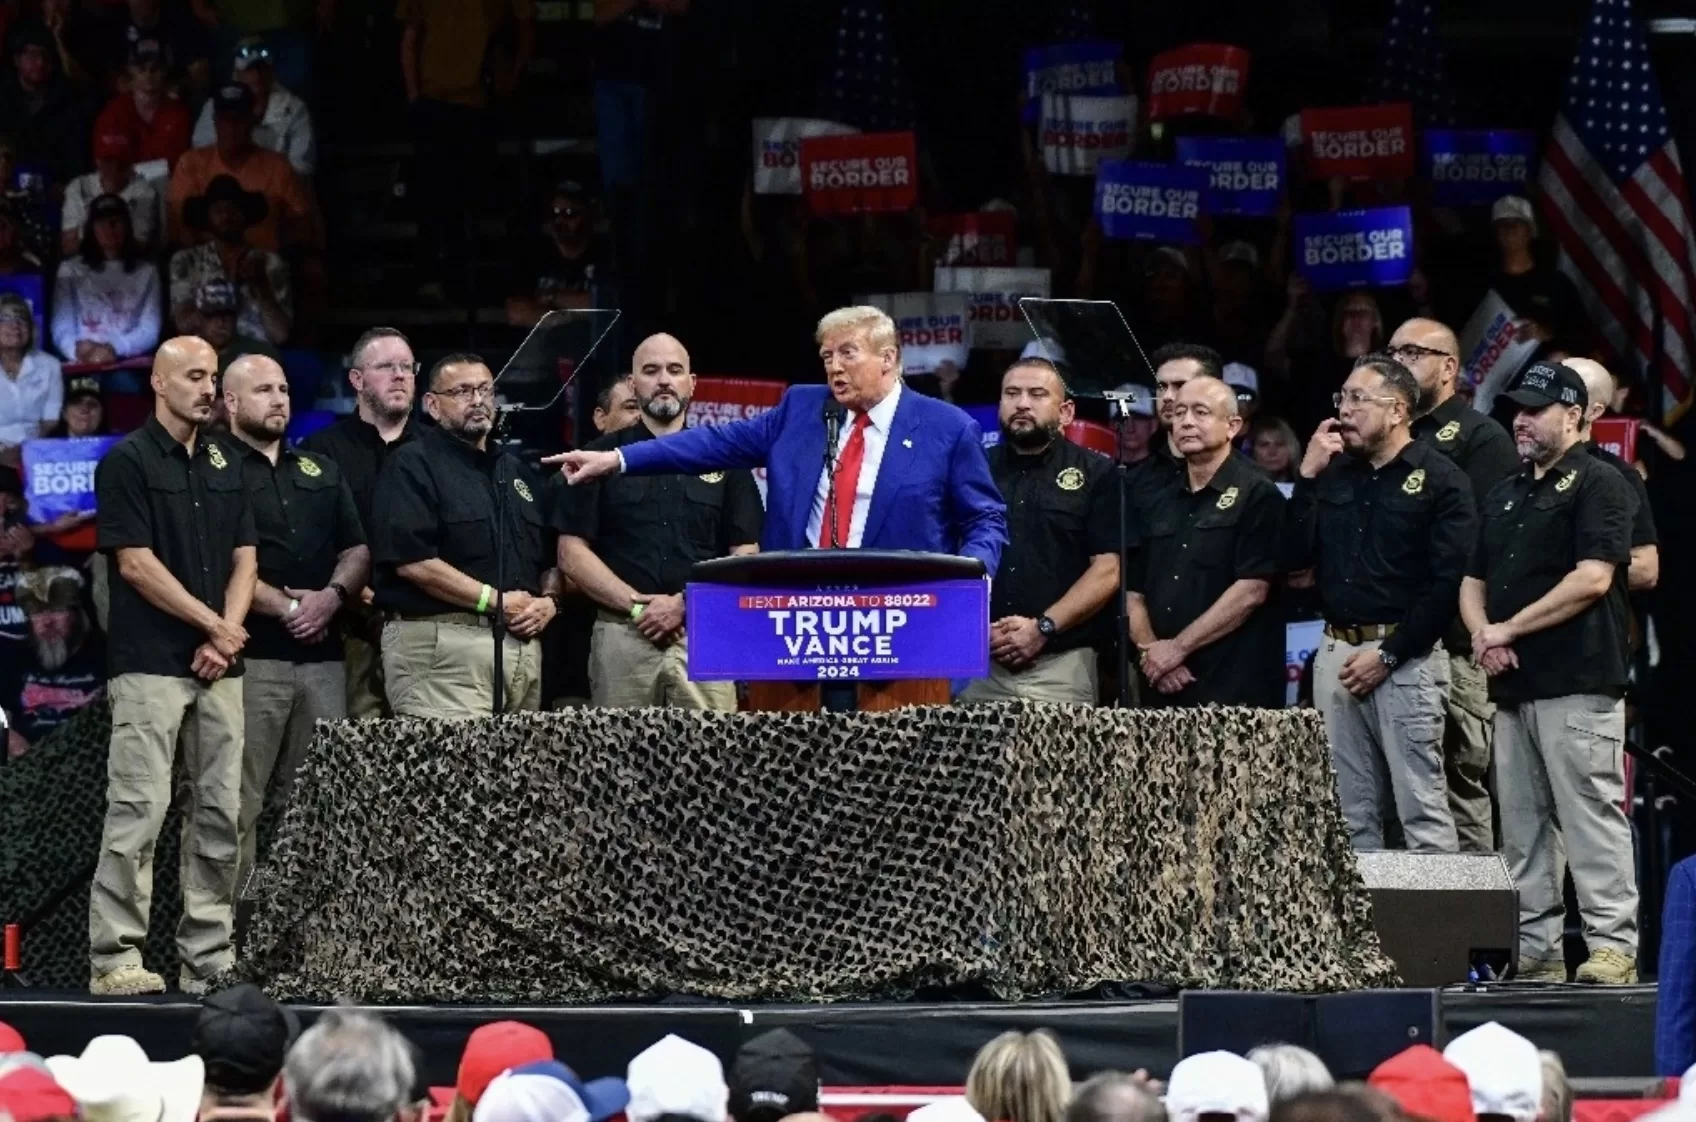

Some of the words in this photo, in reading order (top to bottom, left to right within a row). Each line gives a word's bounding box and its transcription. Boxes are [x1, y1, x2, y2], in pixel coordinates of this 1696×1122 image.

[1312, 137, 1406, 159] BORDER
[811, 158, 870, 173] SECURE
[875, 155, 908, 169] OUR
[1246, 160, 1279, 174] OUR
[1432, 164, 1528, 183] BORDER
[811, 168, 910, 190] BORDER
[1104, 183, 1162, 198] SECURE
[1165, 187, 1199, 204] OUR
[1101, 195, 1200, 218] BORDER
[1304, 232, 1365, 248] SECURE
[1369, 228, 1403, 243] OUR
[1304, 241, 1406, 266] BORDER
[746, 595, 782, 609] TEXT
[787, 594, 857, 608] ARIZONA
[860, 595, 880, 608] TO
[883, 593, 931, 608] 88022
[768, 609, 907, 636] TRUMP
[784, 635, 893, 656] VANCE
[776, 656, 801, 665] MAKE
[803, 656, 839, 665] AMERICA
[841, 656, 868, 665] GREAT
[817, 665, 860, 678] 2024
